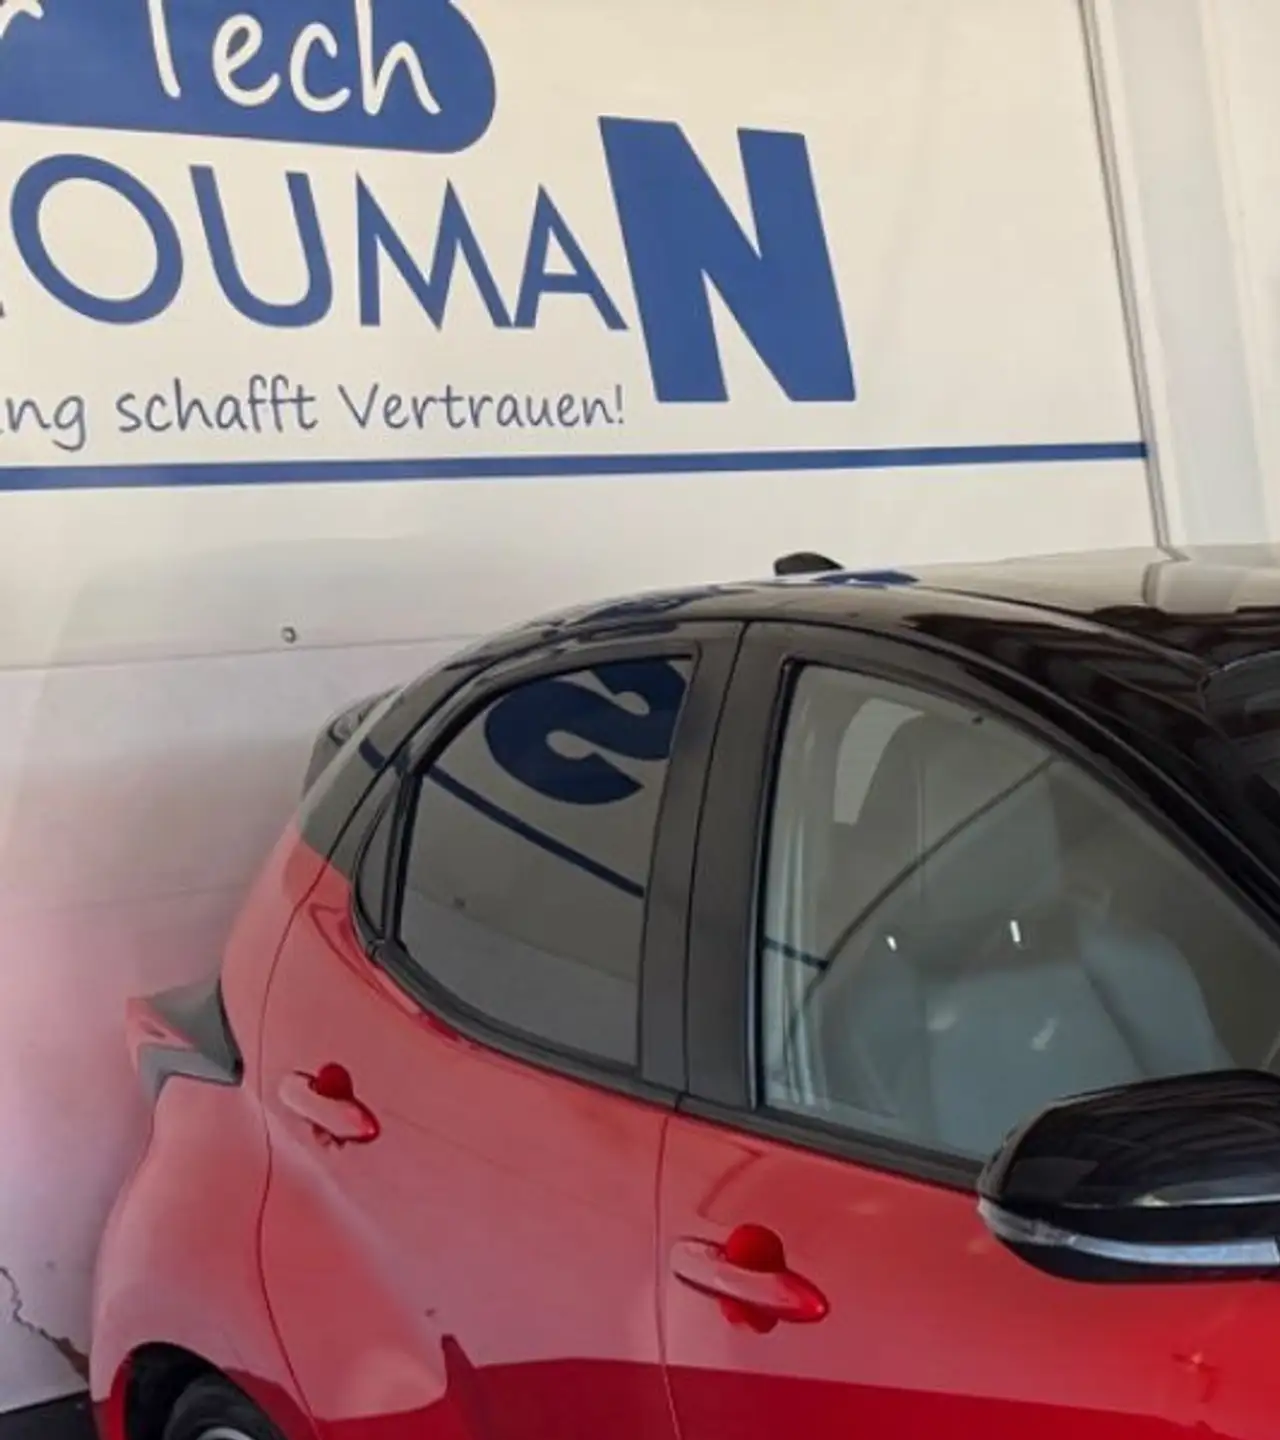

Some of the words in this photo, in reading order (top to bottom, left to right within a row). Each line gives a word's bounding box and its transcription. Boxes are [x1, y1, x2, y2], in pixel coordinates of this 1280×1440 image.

[0, 115, 856, 404] OUMAN
[0, 394, 87, 452] ng
[115, 374, 319, 433] schafft
[337, 383, 625, 429] Vertrauen!
